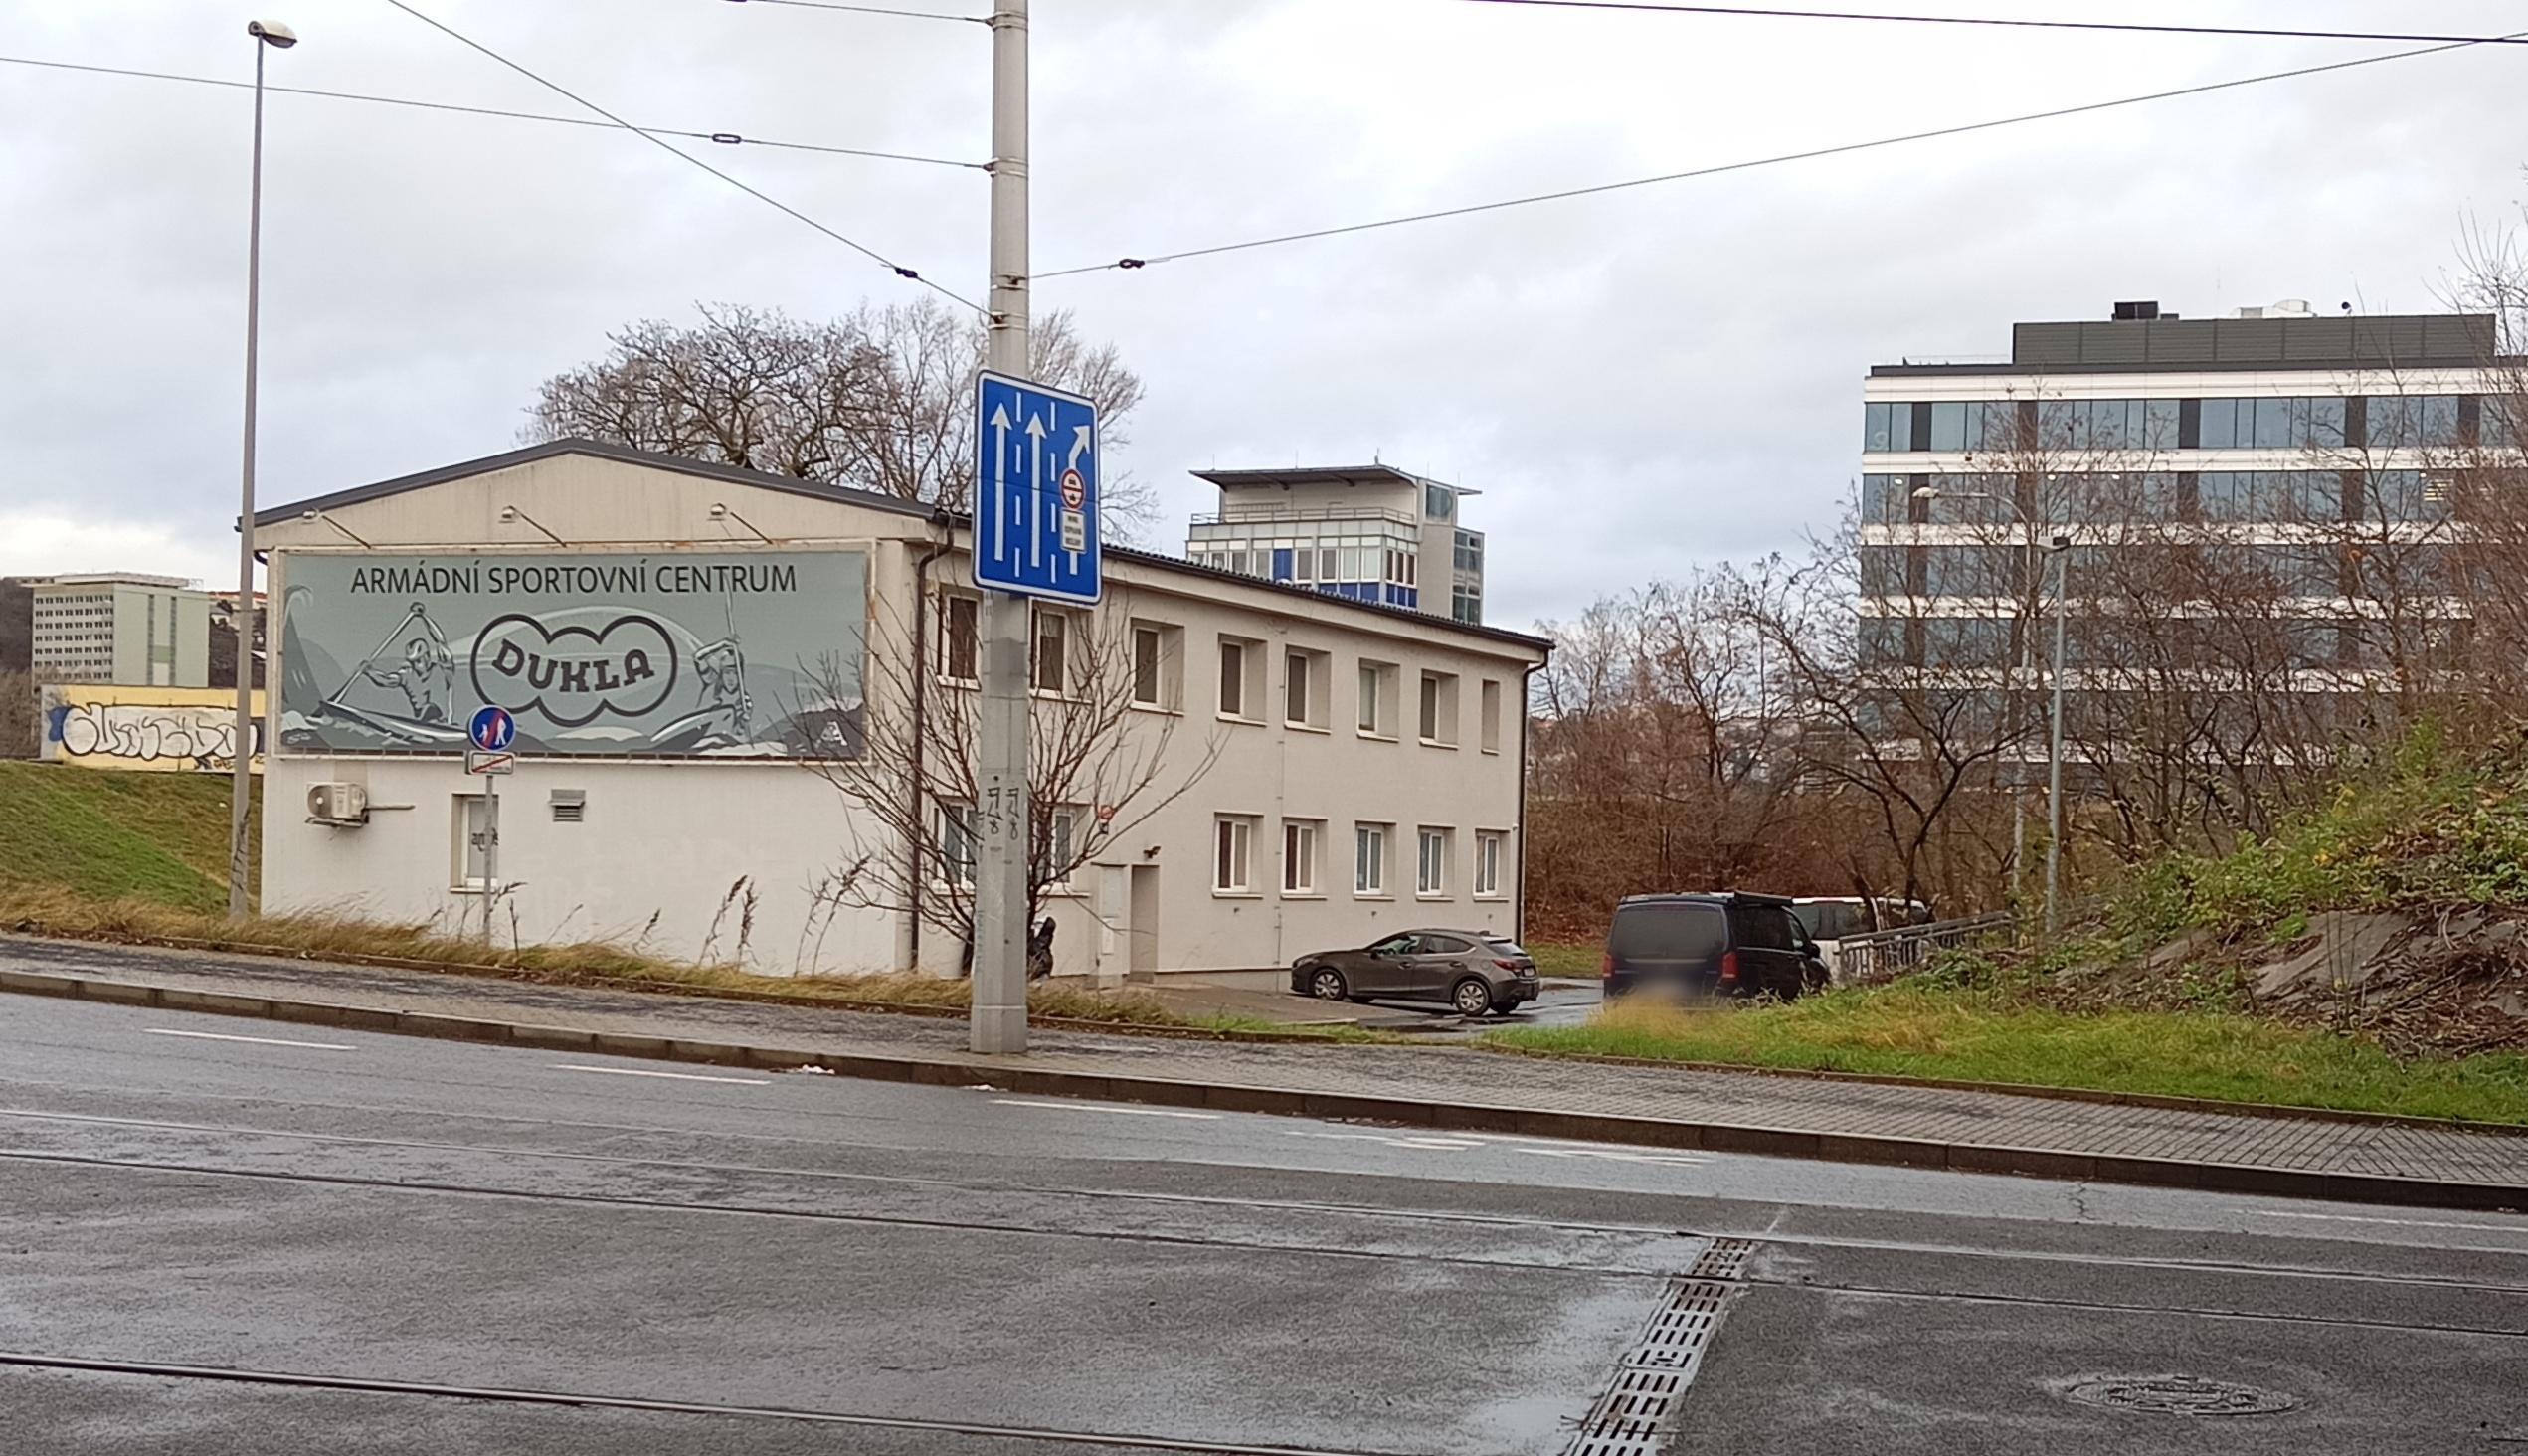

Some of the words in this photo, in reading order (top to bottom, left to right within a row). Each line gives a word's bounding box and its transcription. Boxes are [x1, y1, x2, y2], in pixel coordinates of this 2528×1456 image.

[350, 560, 479, 594] ARMÁDNÍ
[488, 559, 646, 594] SPORTOVNÍ
[656, 566, 797, 593] CENTRUM
[492, 638, 654, 692] DUKLA
